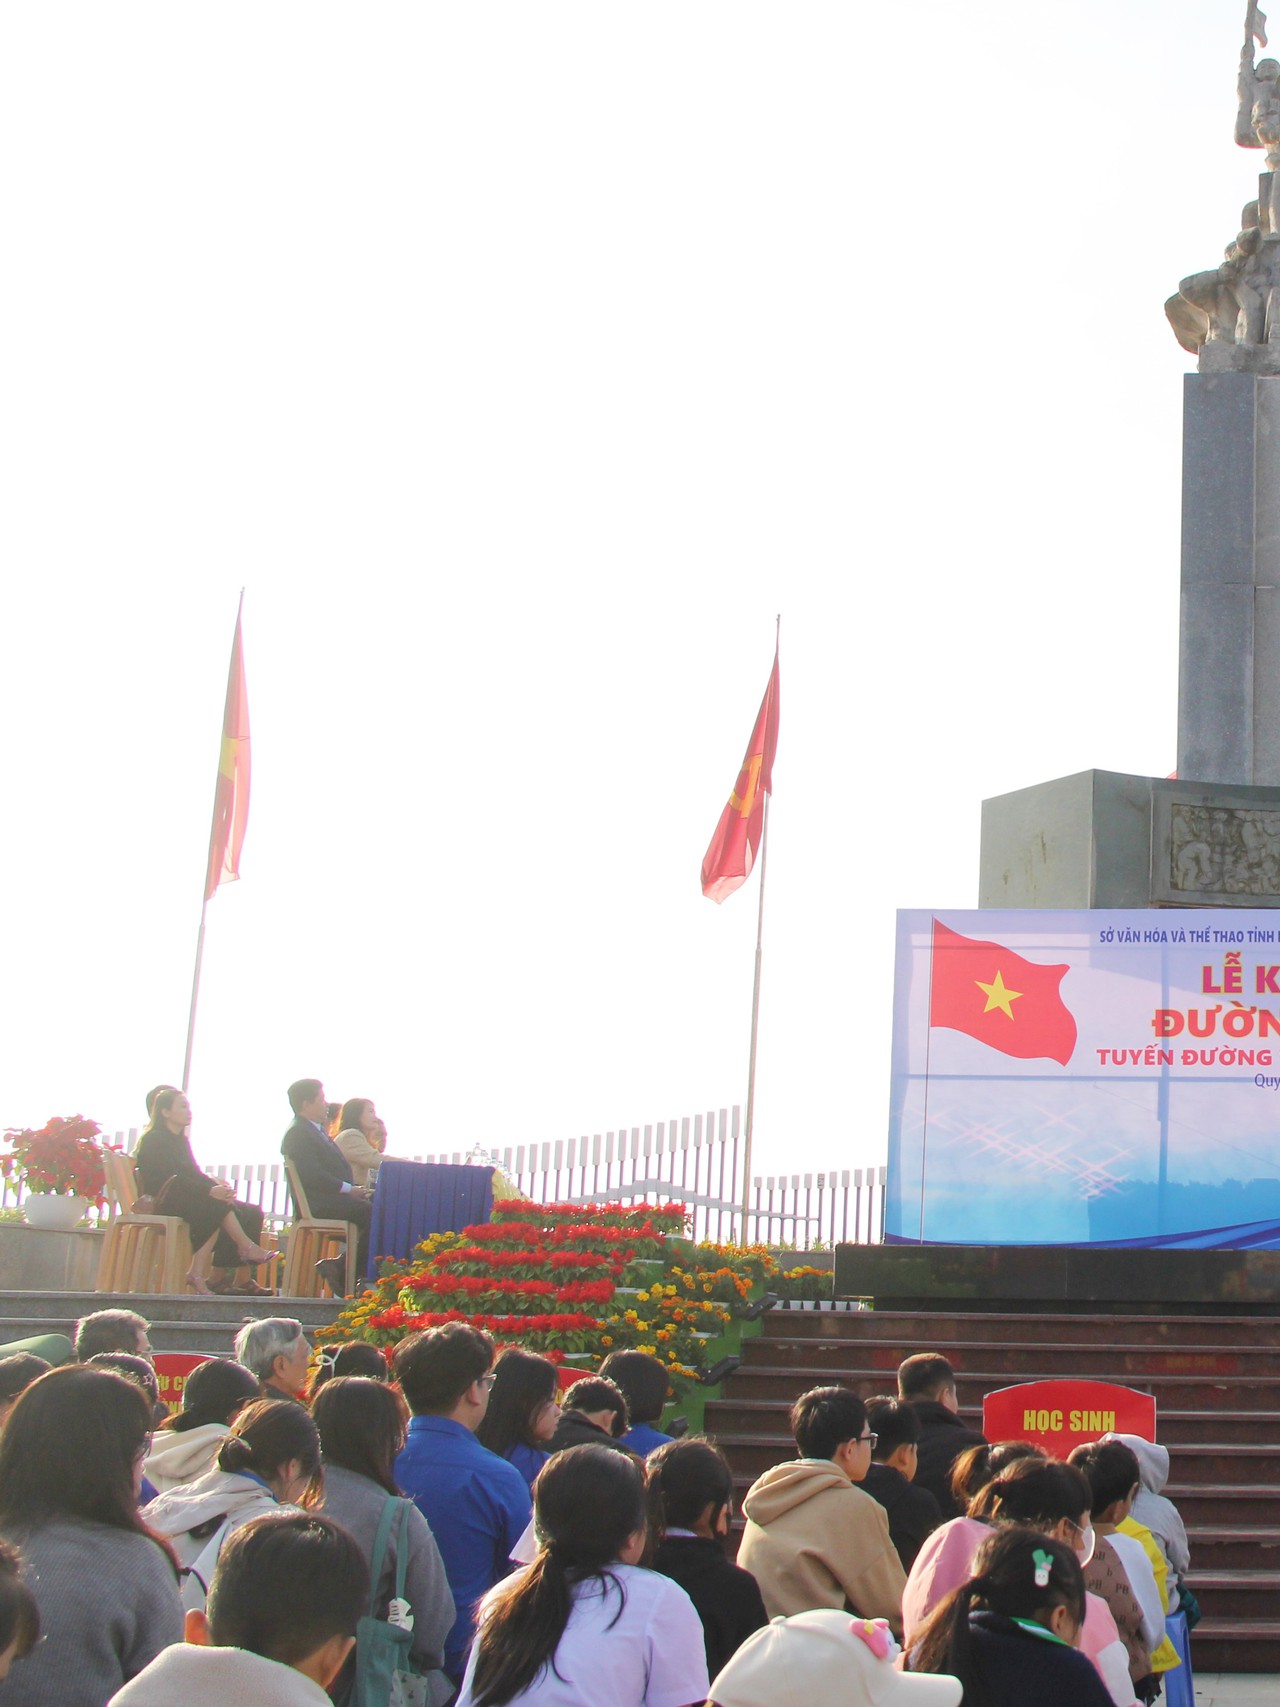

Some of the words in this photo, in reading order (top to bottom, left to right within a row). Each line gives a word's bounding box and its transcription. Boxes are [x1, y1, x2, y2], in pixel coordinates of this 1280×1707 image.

[1099, 928, 1115, 943] SỞ
[1117, 929, 1142, 943] VĂN
[1144, 928, 1168, 943] HÓA
[1171, 928, 1187, 943] VÀ
[1189, 926, 1212, 943] THỂ
[1213, 930, 1245, 943] THAO
[1246, 927, 1275, 943] TỈNH
[1202, 951, 1243, 994] LỄ
[1097, 1043, 1174, 1066] TUYẾN
[1181, 1045, 1273, 1066] ĐƯỜNG
[1254, 1074, 1280, 1091] Quy
[1023, 1410, 1063, 1435] HỌC
[1069, 1411, 1116, 1432] SINH
